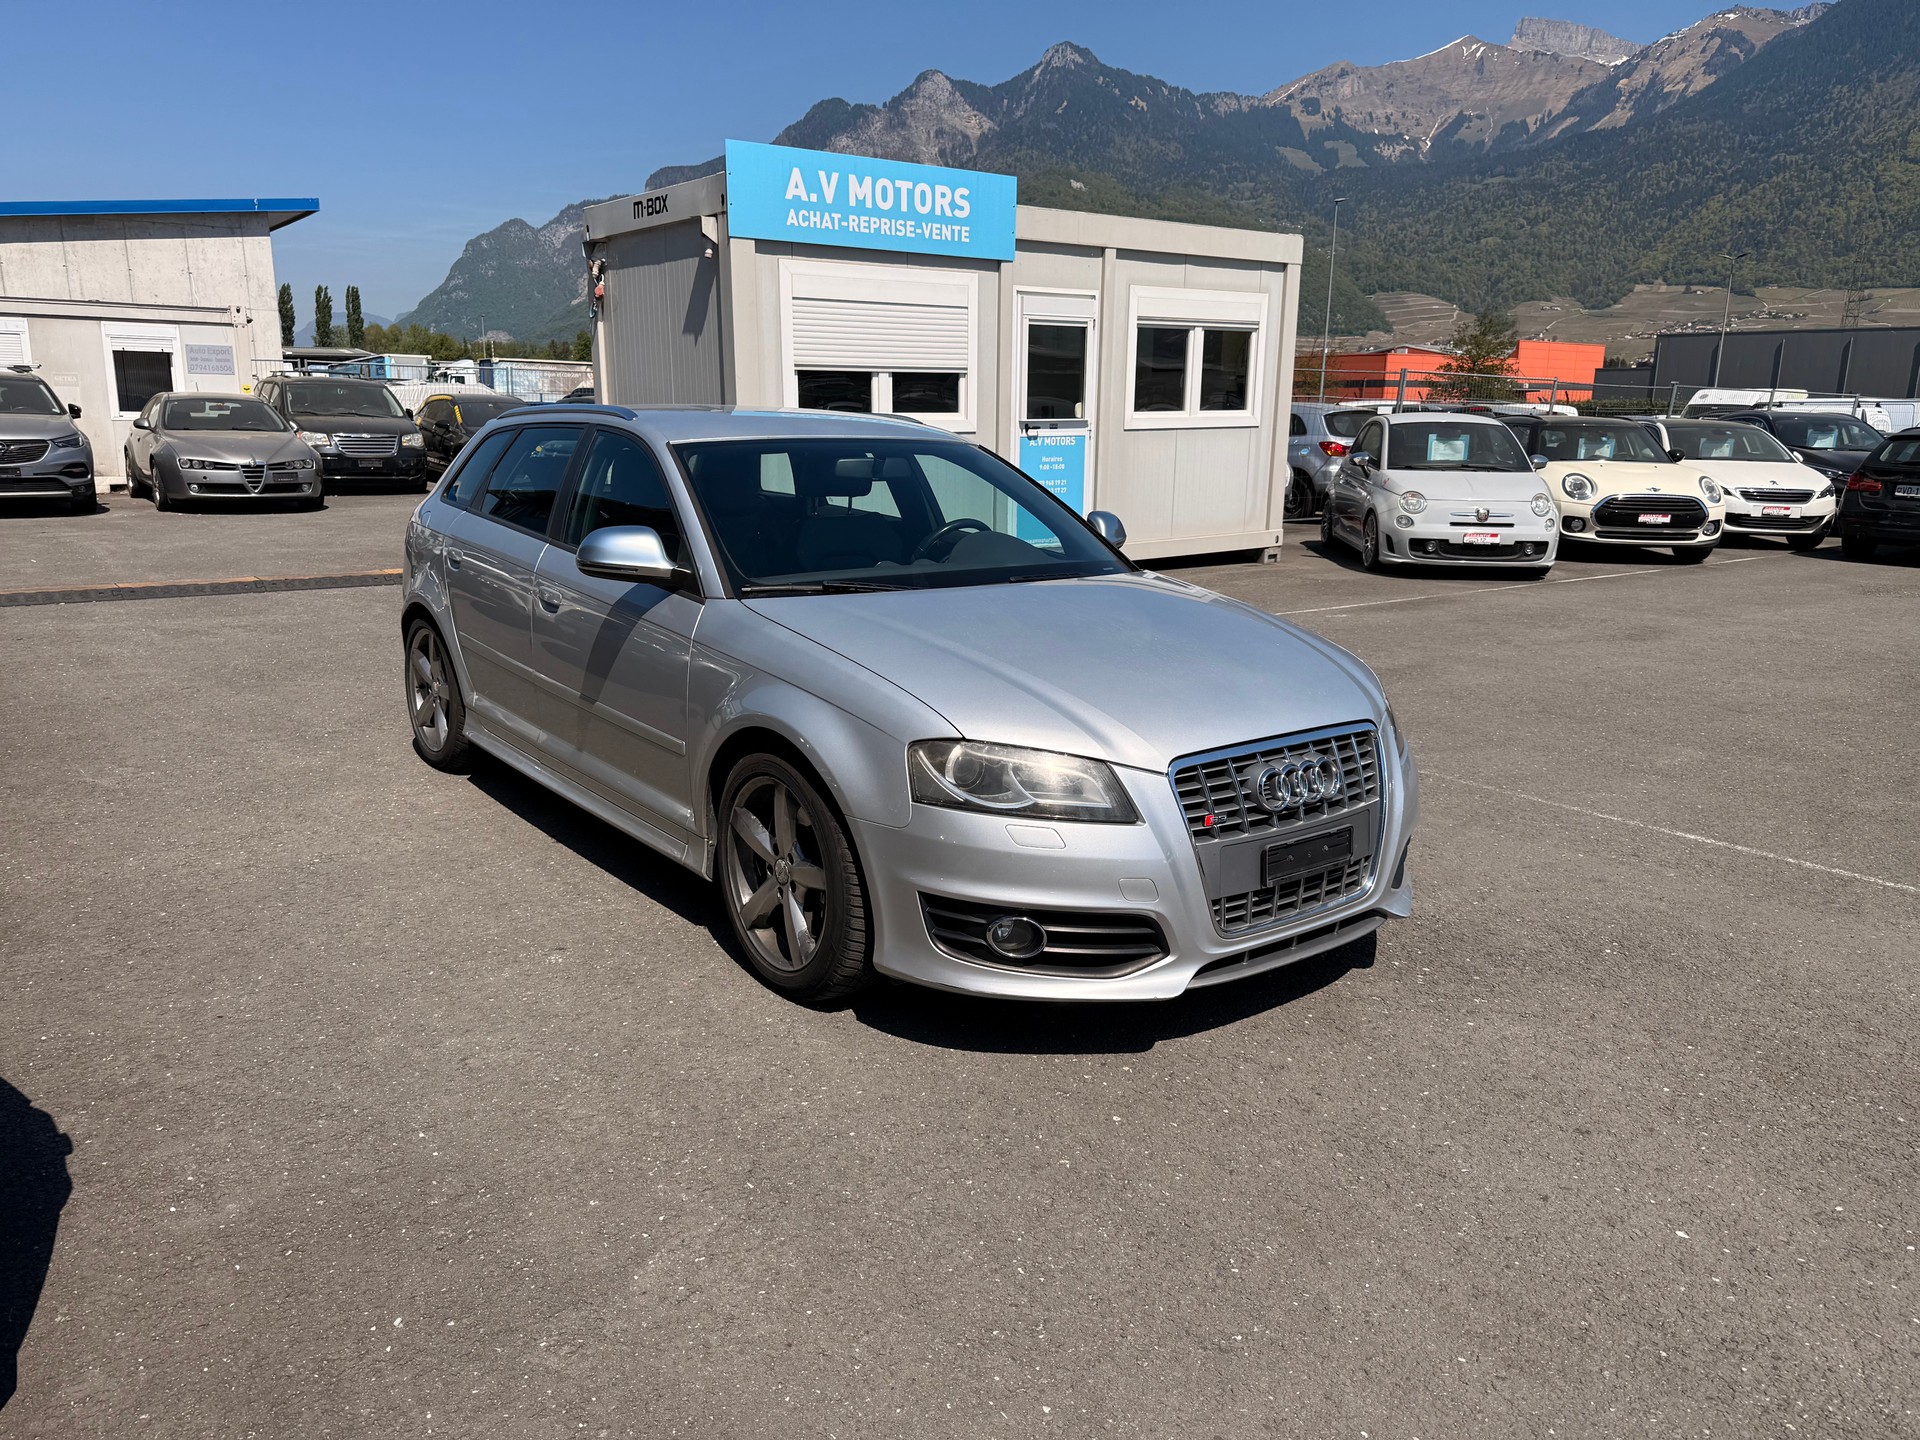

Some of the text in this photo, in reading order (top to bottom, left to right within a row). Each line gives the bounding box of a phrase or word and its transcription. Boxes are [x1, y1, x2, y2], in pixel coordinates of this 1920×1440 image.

[785, 167, 971, 219] A.V MOTORS
[786, 208, 970, 243] ACHAT-REPRISE-VENTE
[189, 346, 230, 356] Auto Export
[1044, 436, 1076, 446] MOTORS
